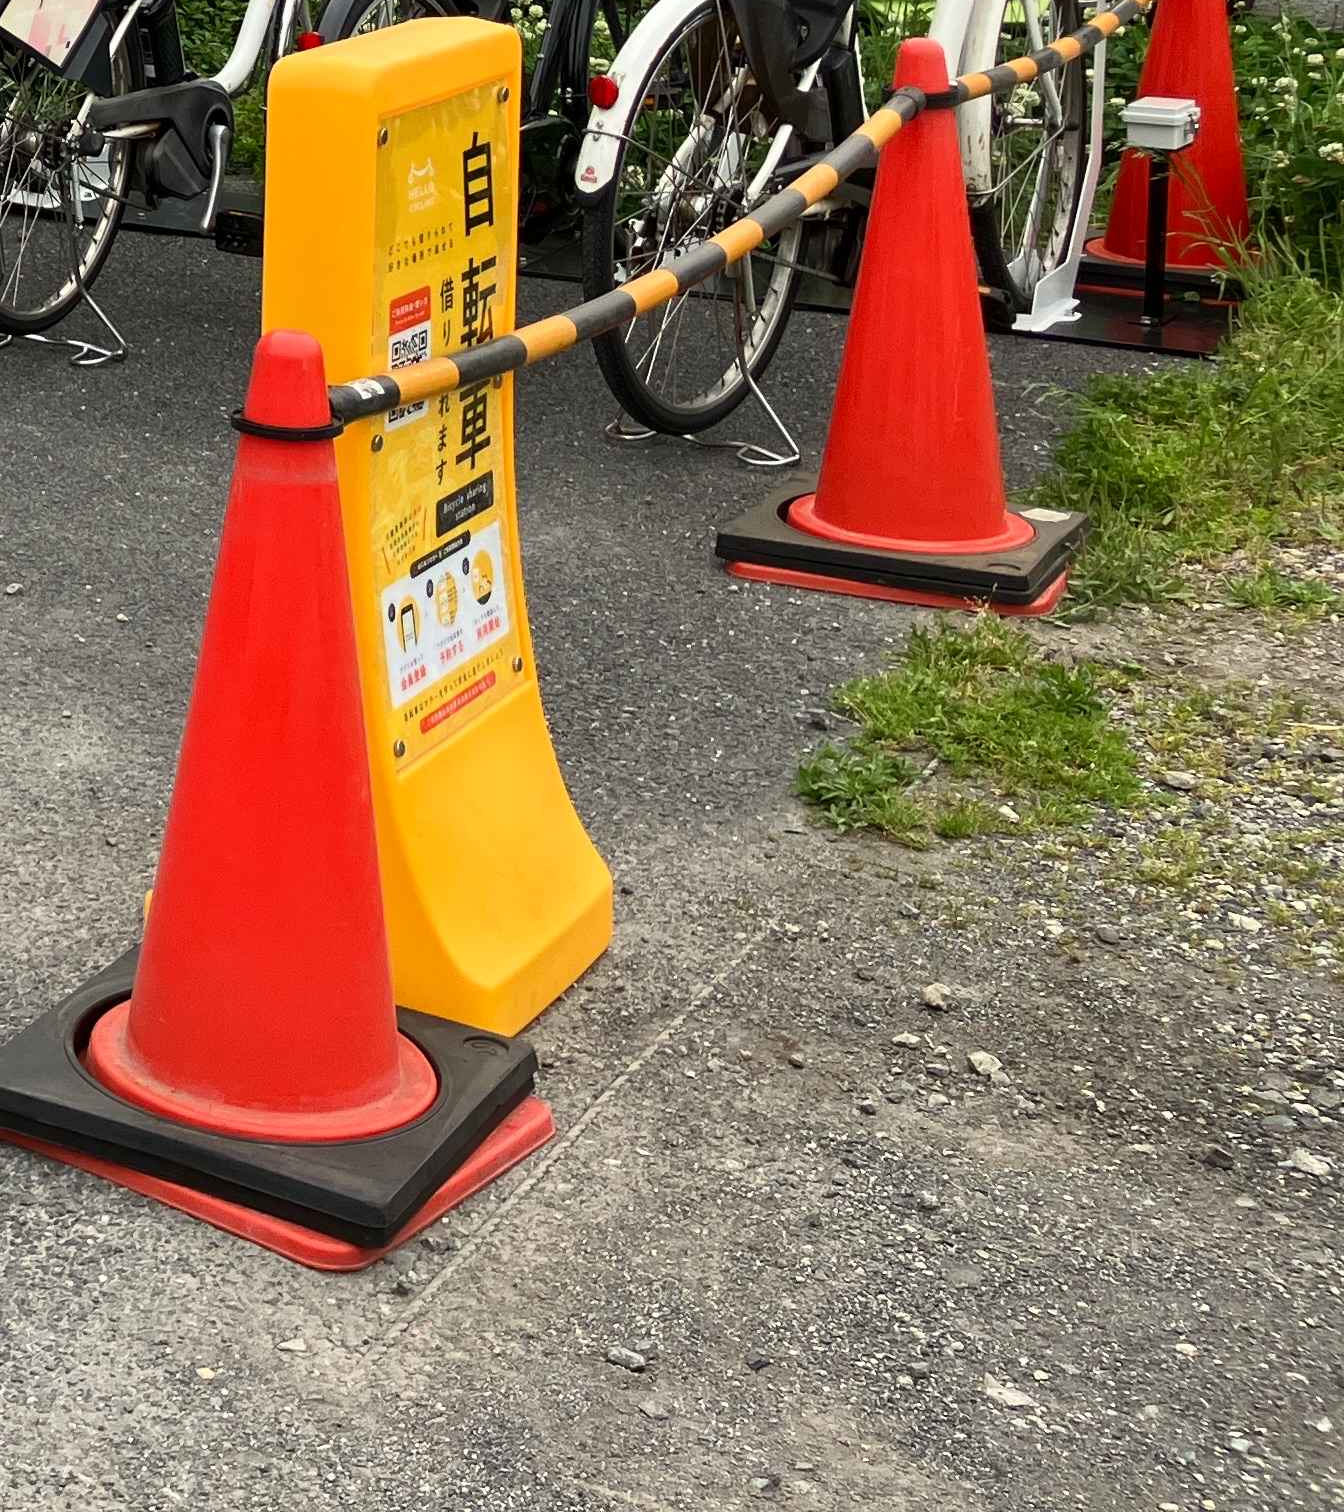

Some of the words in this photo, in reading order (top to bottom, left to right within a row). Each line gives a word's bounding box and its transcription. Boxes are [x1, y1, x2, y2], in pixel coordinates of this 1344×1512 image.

[436, 275, 454, 486] 借りれます
[455, 130, 497, 471] 自転車
